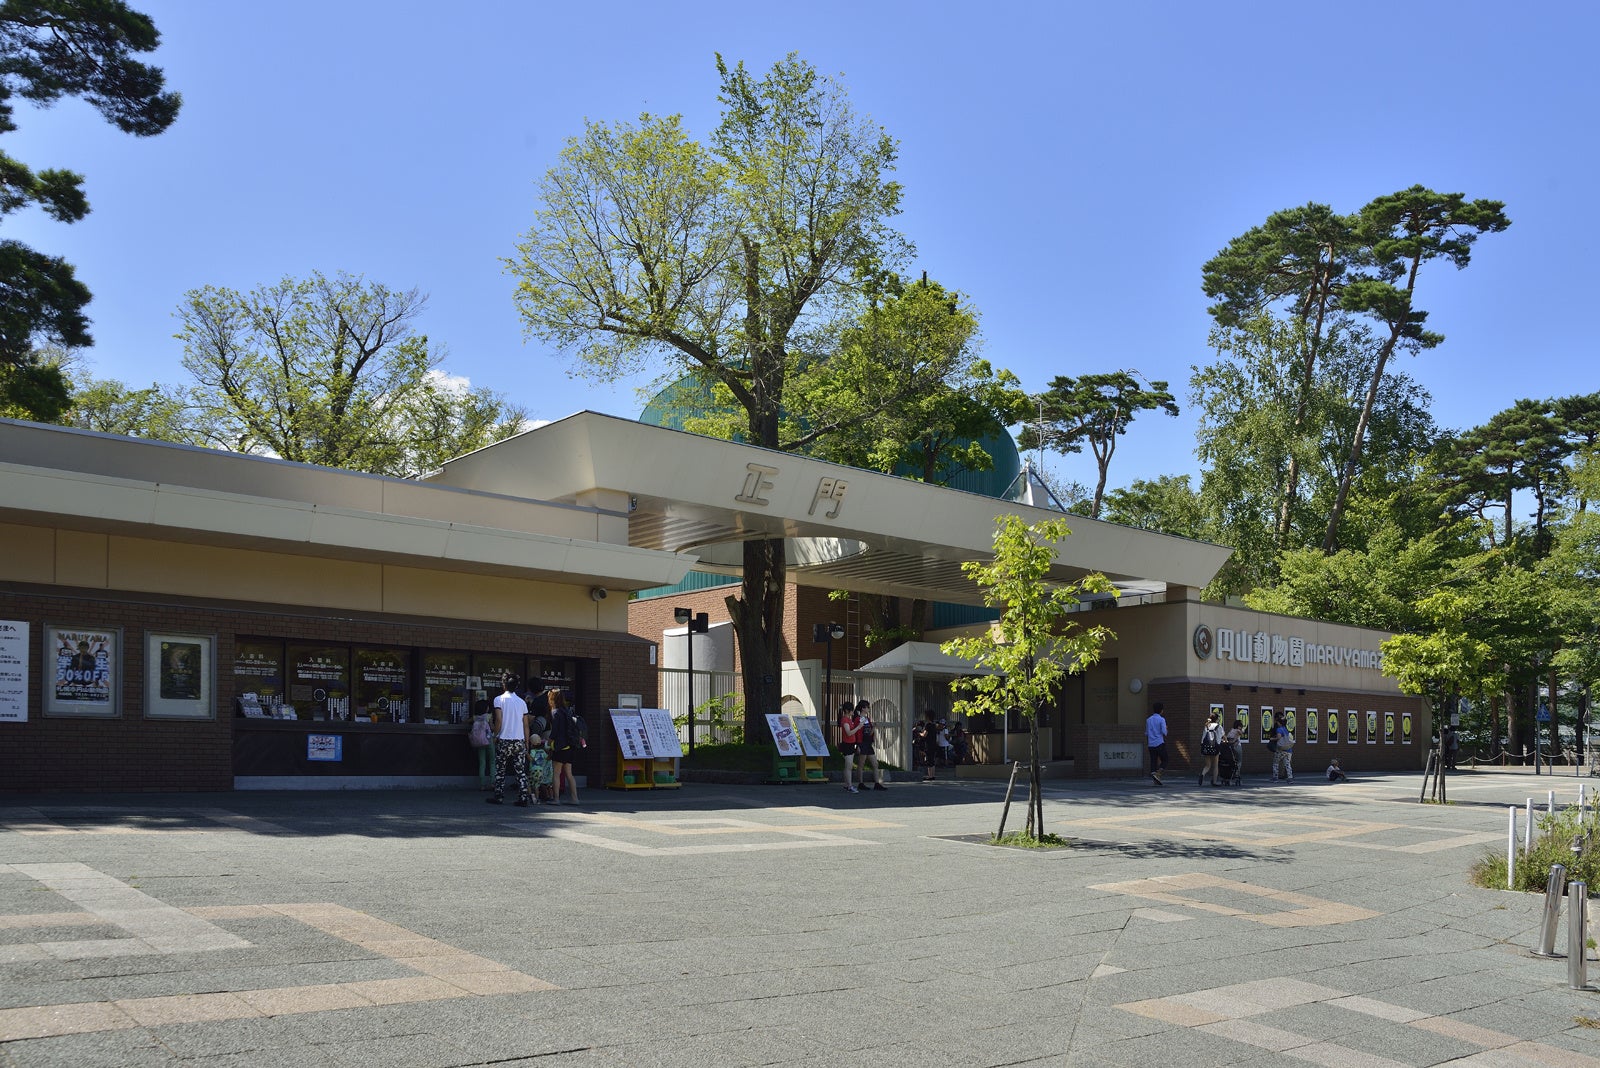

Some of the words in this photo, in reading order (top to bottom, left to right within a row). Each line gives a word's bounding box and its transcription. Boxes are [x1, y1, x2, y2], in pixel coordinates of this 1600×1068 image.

[734, 462, 849, 519] 正門
[1217, 628, 1305, 668] 円山動物園
[56, 669, 109, 681] 50%OFF
